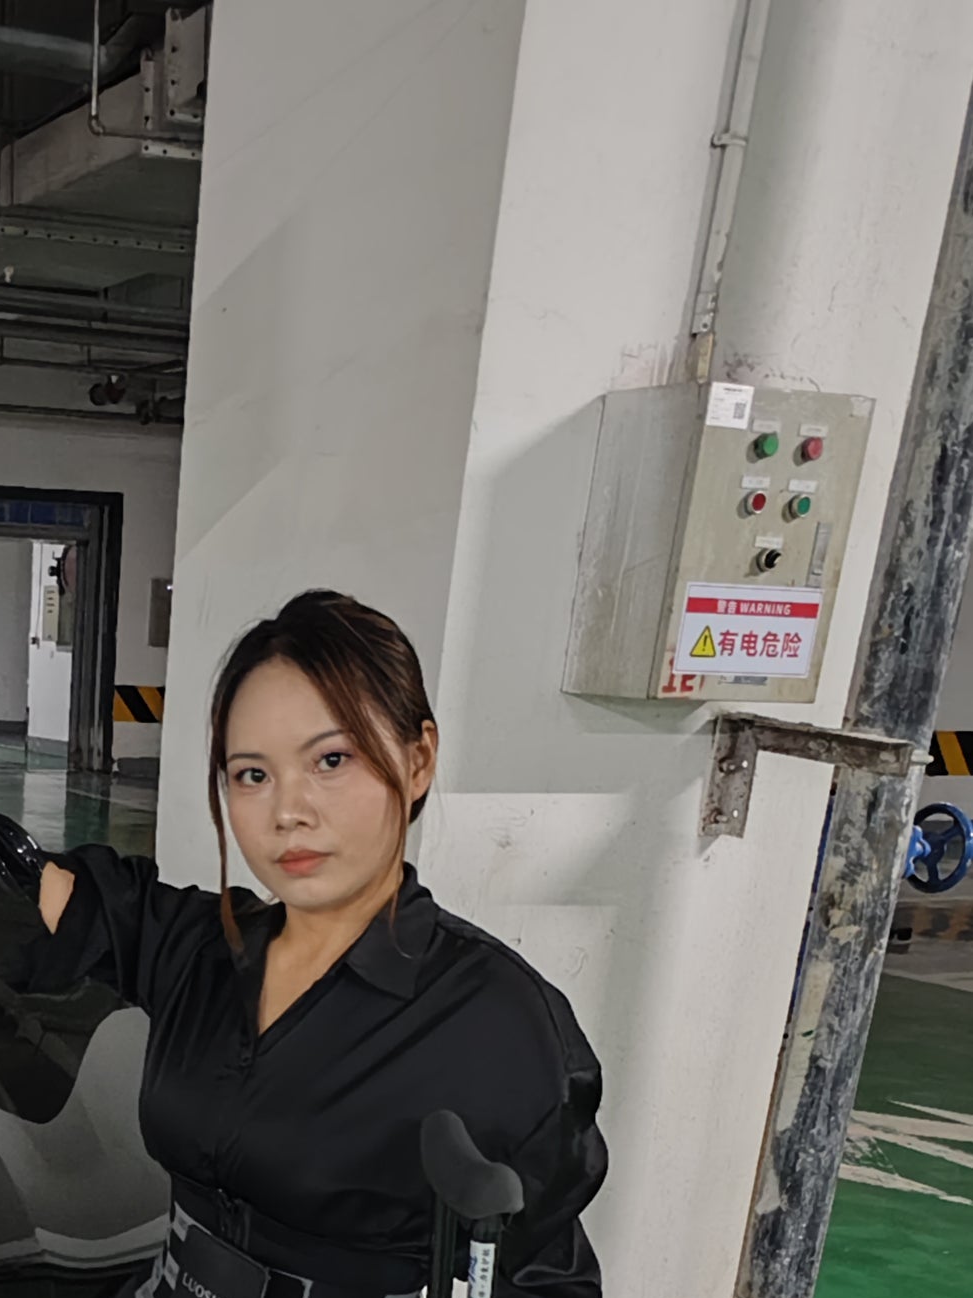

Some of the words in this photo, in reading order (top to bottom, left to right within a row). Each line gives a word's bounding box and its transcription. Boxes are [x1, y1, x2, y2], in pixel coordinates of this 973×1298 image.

[717, 599, 738, 615] 警告
[739, 602, 792, 616] WARNING
[717, 629, 802, 659] 有电危险
